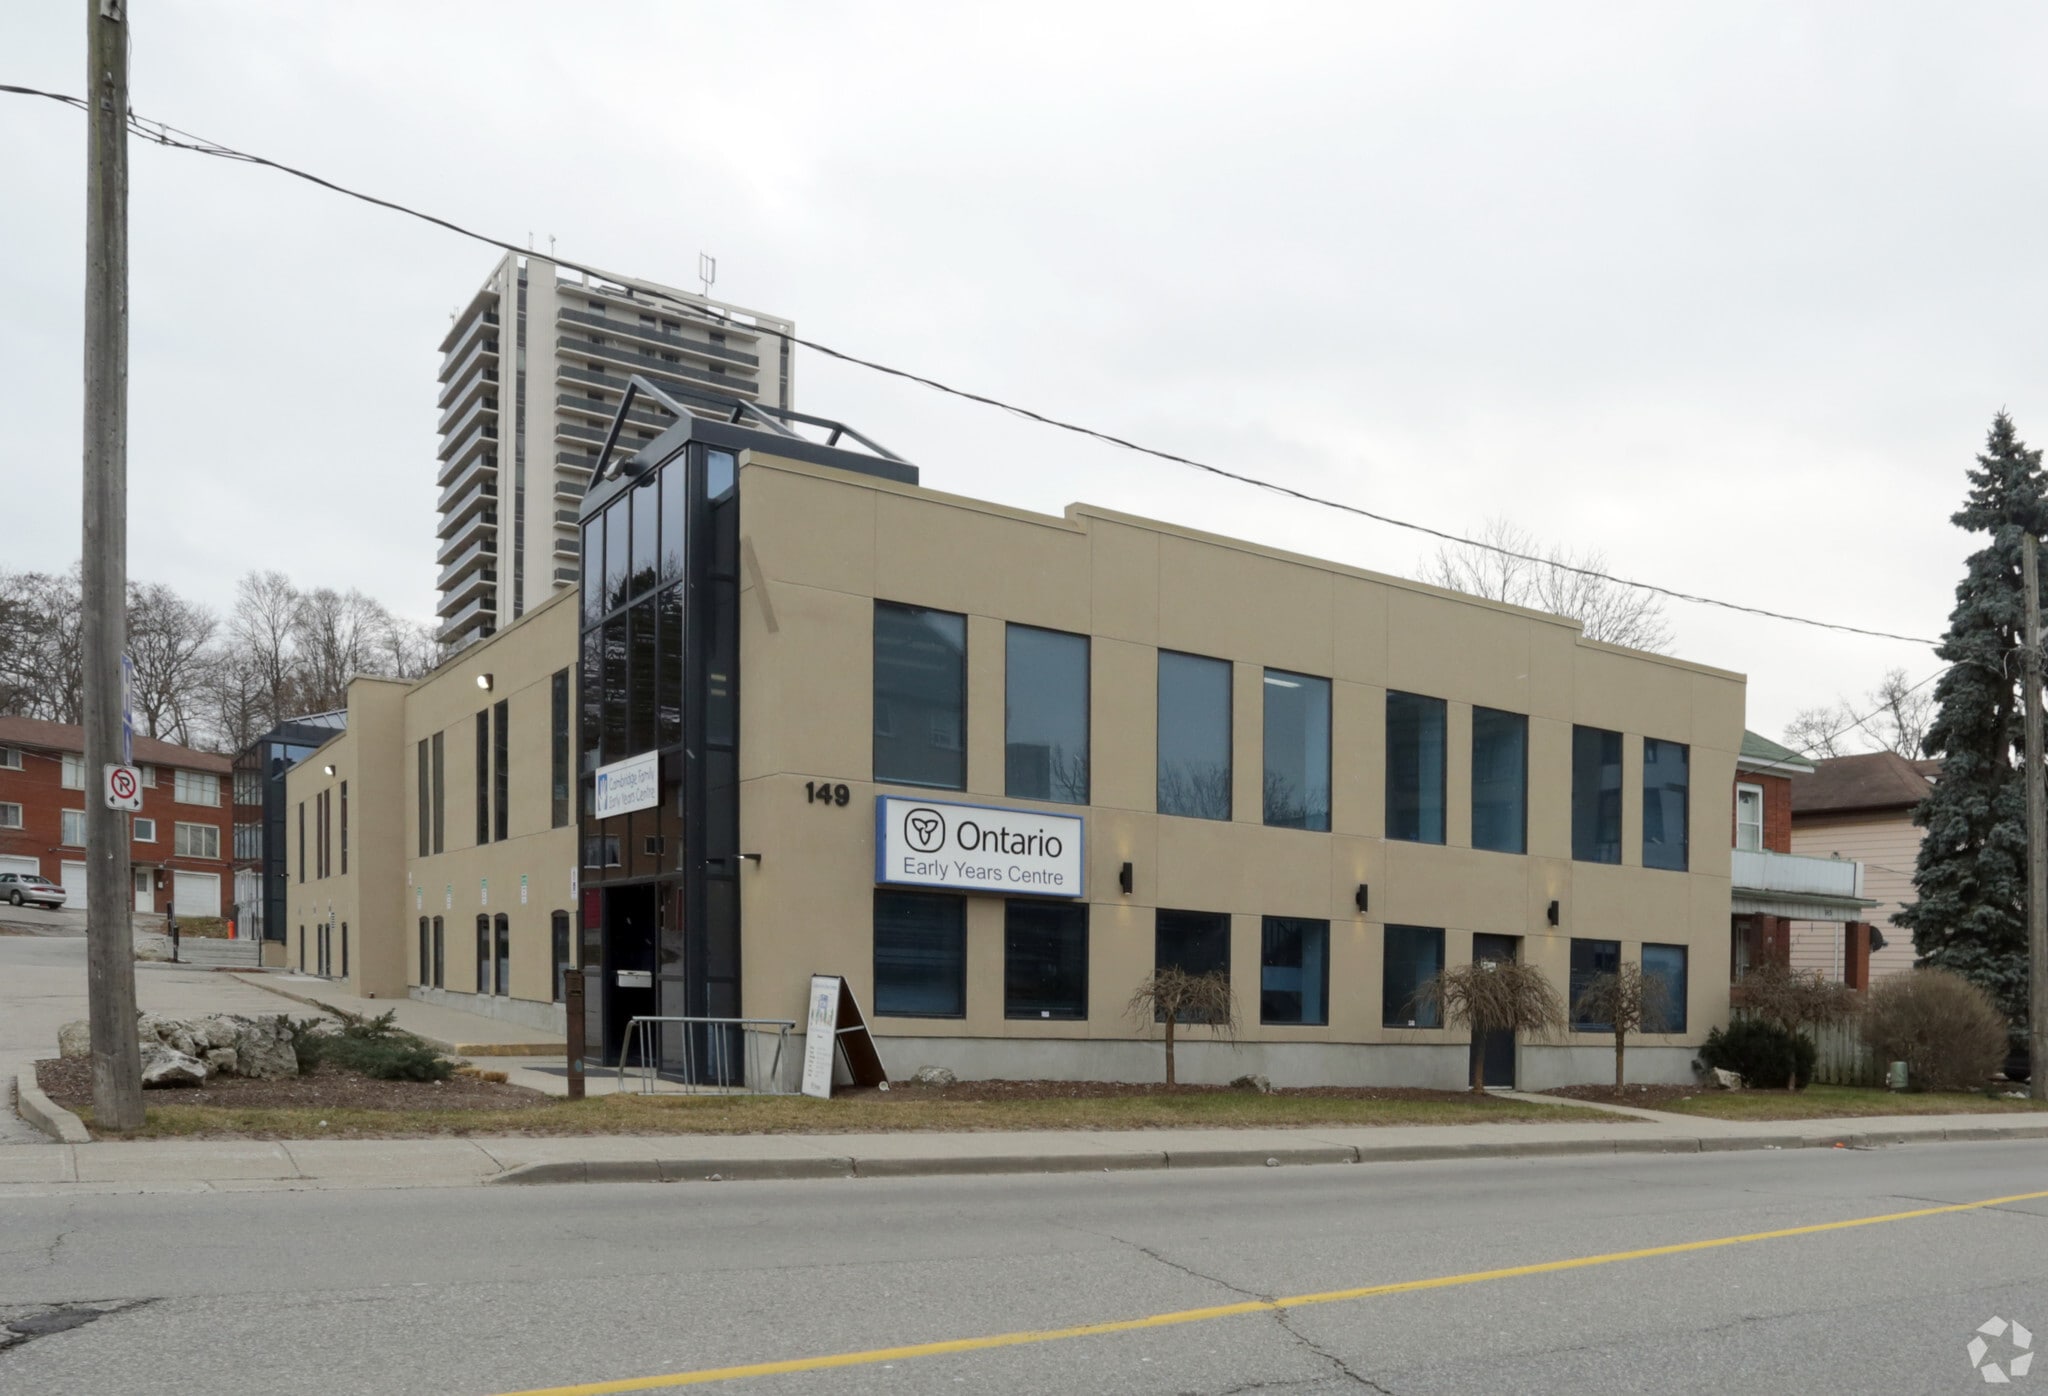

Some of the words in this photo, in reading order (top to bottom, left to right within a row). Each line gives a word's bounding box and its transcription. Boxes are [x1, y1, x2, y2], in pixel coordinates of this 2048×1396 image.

[806, 781, 849, 807] 149
[957, 821, 1062, 858] Ontario
[904, 857, 948, 880] Early
[954, 861, 1002, 881] Years
[1008, 866, 1063, 886] Centre
